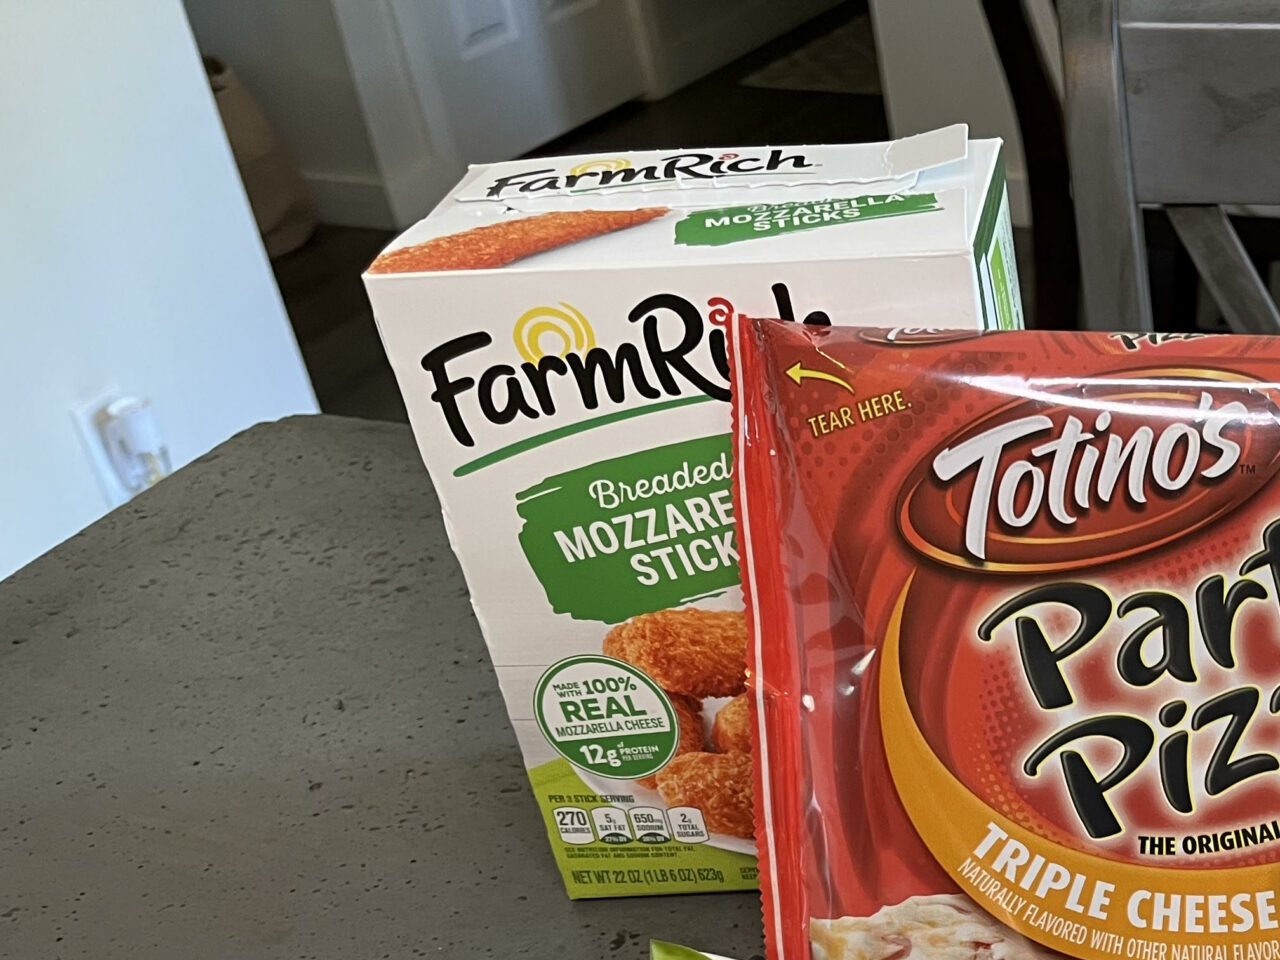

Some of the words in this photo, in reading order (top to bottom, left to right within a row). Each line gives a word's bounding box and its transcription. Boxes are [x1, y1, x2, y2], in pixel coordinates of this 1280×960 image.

[705, 194, 905, 228] MOZZARELLA
[753, 208, 861, 231] STICKS
[421, 284, 831, 448] FarmRi
[808, 407, 854, 438] TEAR
[857, 391, 913, 424] HERE.
[588, 453, 735, 509] Breaded
[933, 391, 1248, 560] Totino's
[553, 489, 737, 563] MOZZARE
[630, 531, 740, 587] STICK
[552, 682, 580, 691] MADE
[557, 690, 582, 698] WITH
[582, 676, 637, 695] 100%
[559, 695, 647, 723] REAL
[556, 720, 624, 737] MOZZARELLA
[624, 717, 665, 731] CHEESE
[580, 744, 622, 767] 12g
[620, 745, 659, 755] PROTEIN
[548, 795, 565, 803] PER
[574, 795, 597, 803] STICK
[600, 795, 635, 803] SERVING
[557, 811, 587, 826] 270
[1138, 835, 1176, 855] THE
[571, 870, 594, 884] NET
[595, 870, 611, 884] WT
[613, 870, 627, 884] 22
[628, 870, 643, 883] OZ
[655, 869, 668, 882] LB
[669, 868, 678, 882] 6
[973, 822, 1116, 920] TRIPLE
[1127, 890, 1279, 933] CHEESE
[957, 857, 1028, 917] NATURALLY
[1022, 902, 1087, 946] FLAVORED
[1091, 930, 1123, 955] WITH
